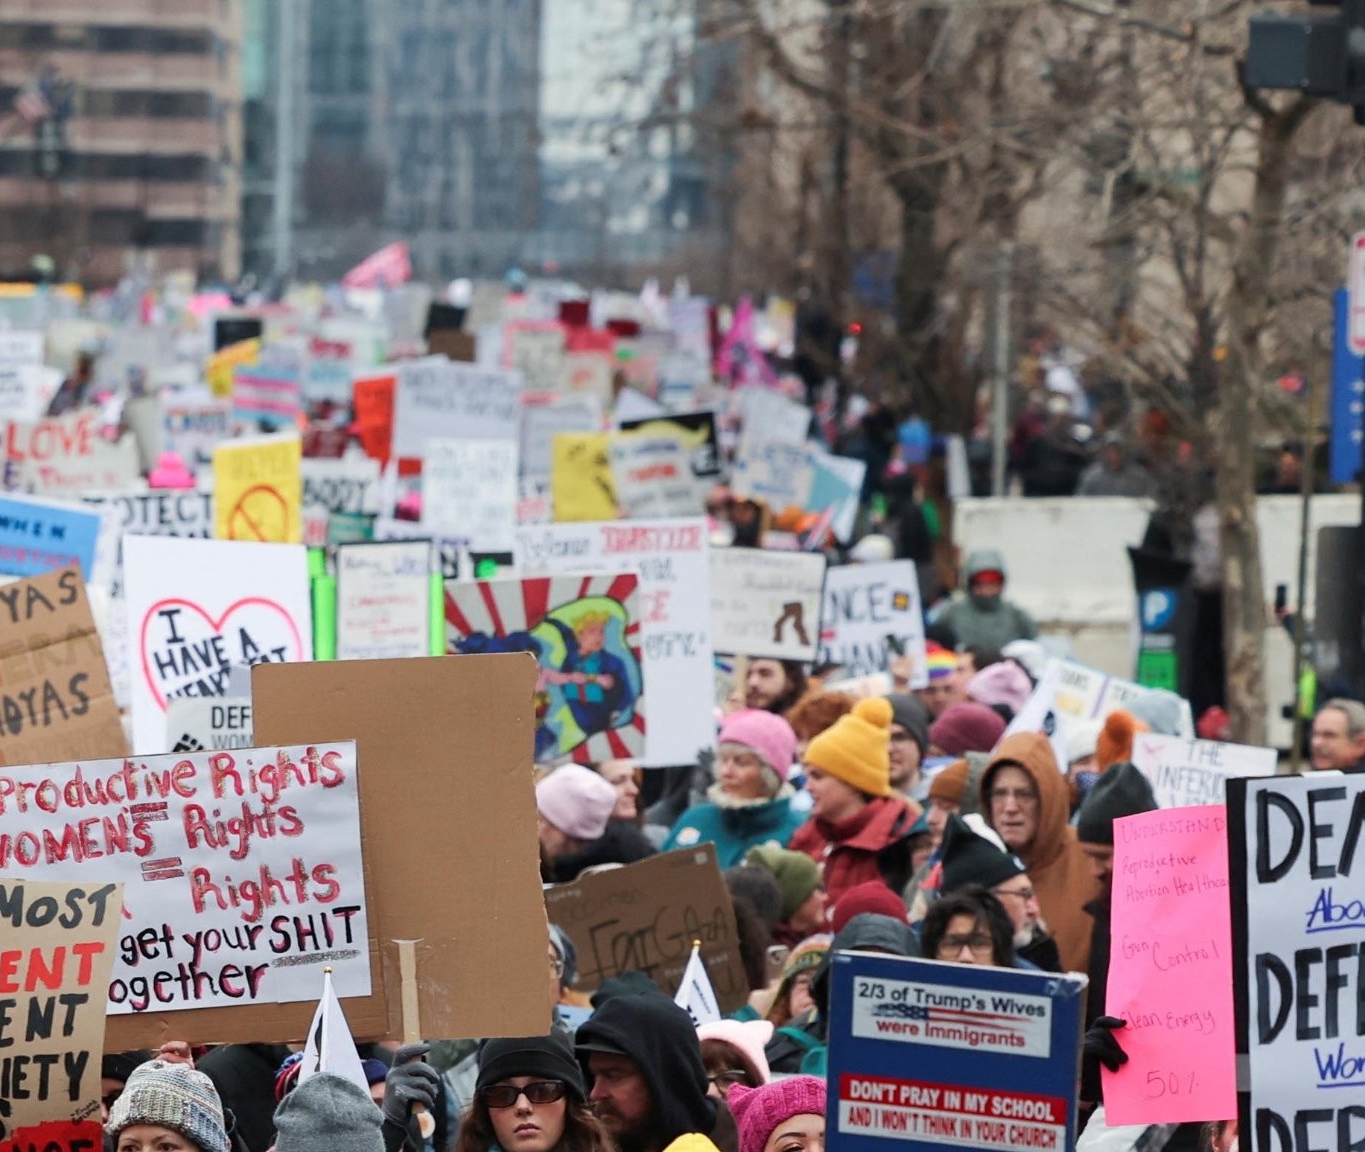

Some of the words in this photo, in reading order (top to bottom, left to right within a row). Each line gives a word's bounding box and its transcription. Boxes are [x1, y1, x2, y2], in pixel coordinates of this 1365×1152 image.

[159, 608, 185, 643] I
[154, 635, 230, 680] HAVE
[209, 745, 346, 807] Rights
[183, 801, 305, 861] Rights
[189, 857, 343, 924] Rights
[120, 923, 174, 967] get
[182, 923, 264, 968] your
[267, 905, 361, 954] SHIT
[108, 958, 270, 1014] ogether
[858, 982, 885, 999] 2/3
[891, 985, 910, 1002] of
[913, 988, 987, 1011] Trump's
[991, 996, 1046, 1018] Wives
[875, 1019, 920, 1036] were
[924, 1021, 1027, 1048] Immigrants
[849, 1078, 897, 1103] DON'T
[899, 1083, 942, 1109] PRAY
[943, 1090, 962, 1111] IN
[963, 1093, 990, 1115] MY
[990, 1096, 1056, 1122] SCHOOL
[848, 1105, 874, 1127] AND
[873, 1107, 880, 1127] I
[880, 1108, 919, 1132] WON'T
[922, 1112, 959, 1137] THINK
[960, 1117, 972, 1138] IN
[975, 1118, 1007, 1143] YOUR
[1008, 1124, 1058, 1150] CHURCH
